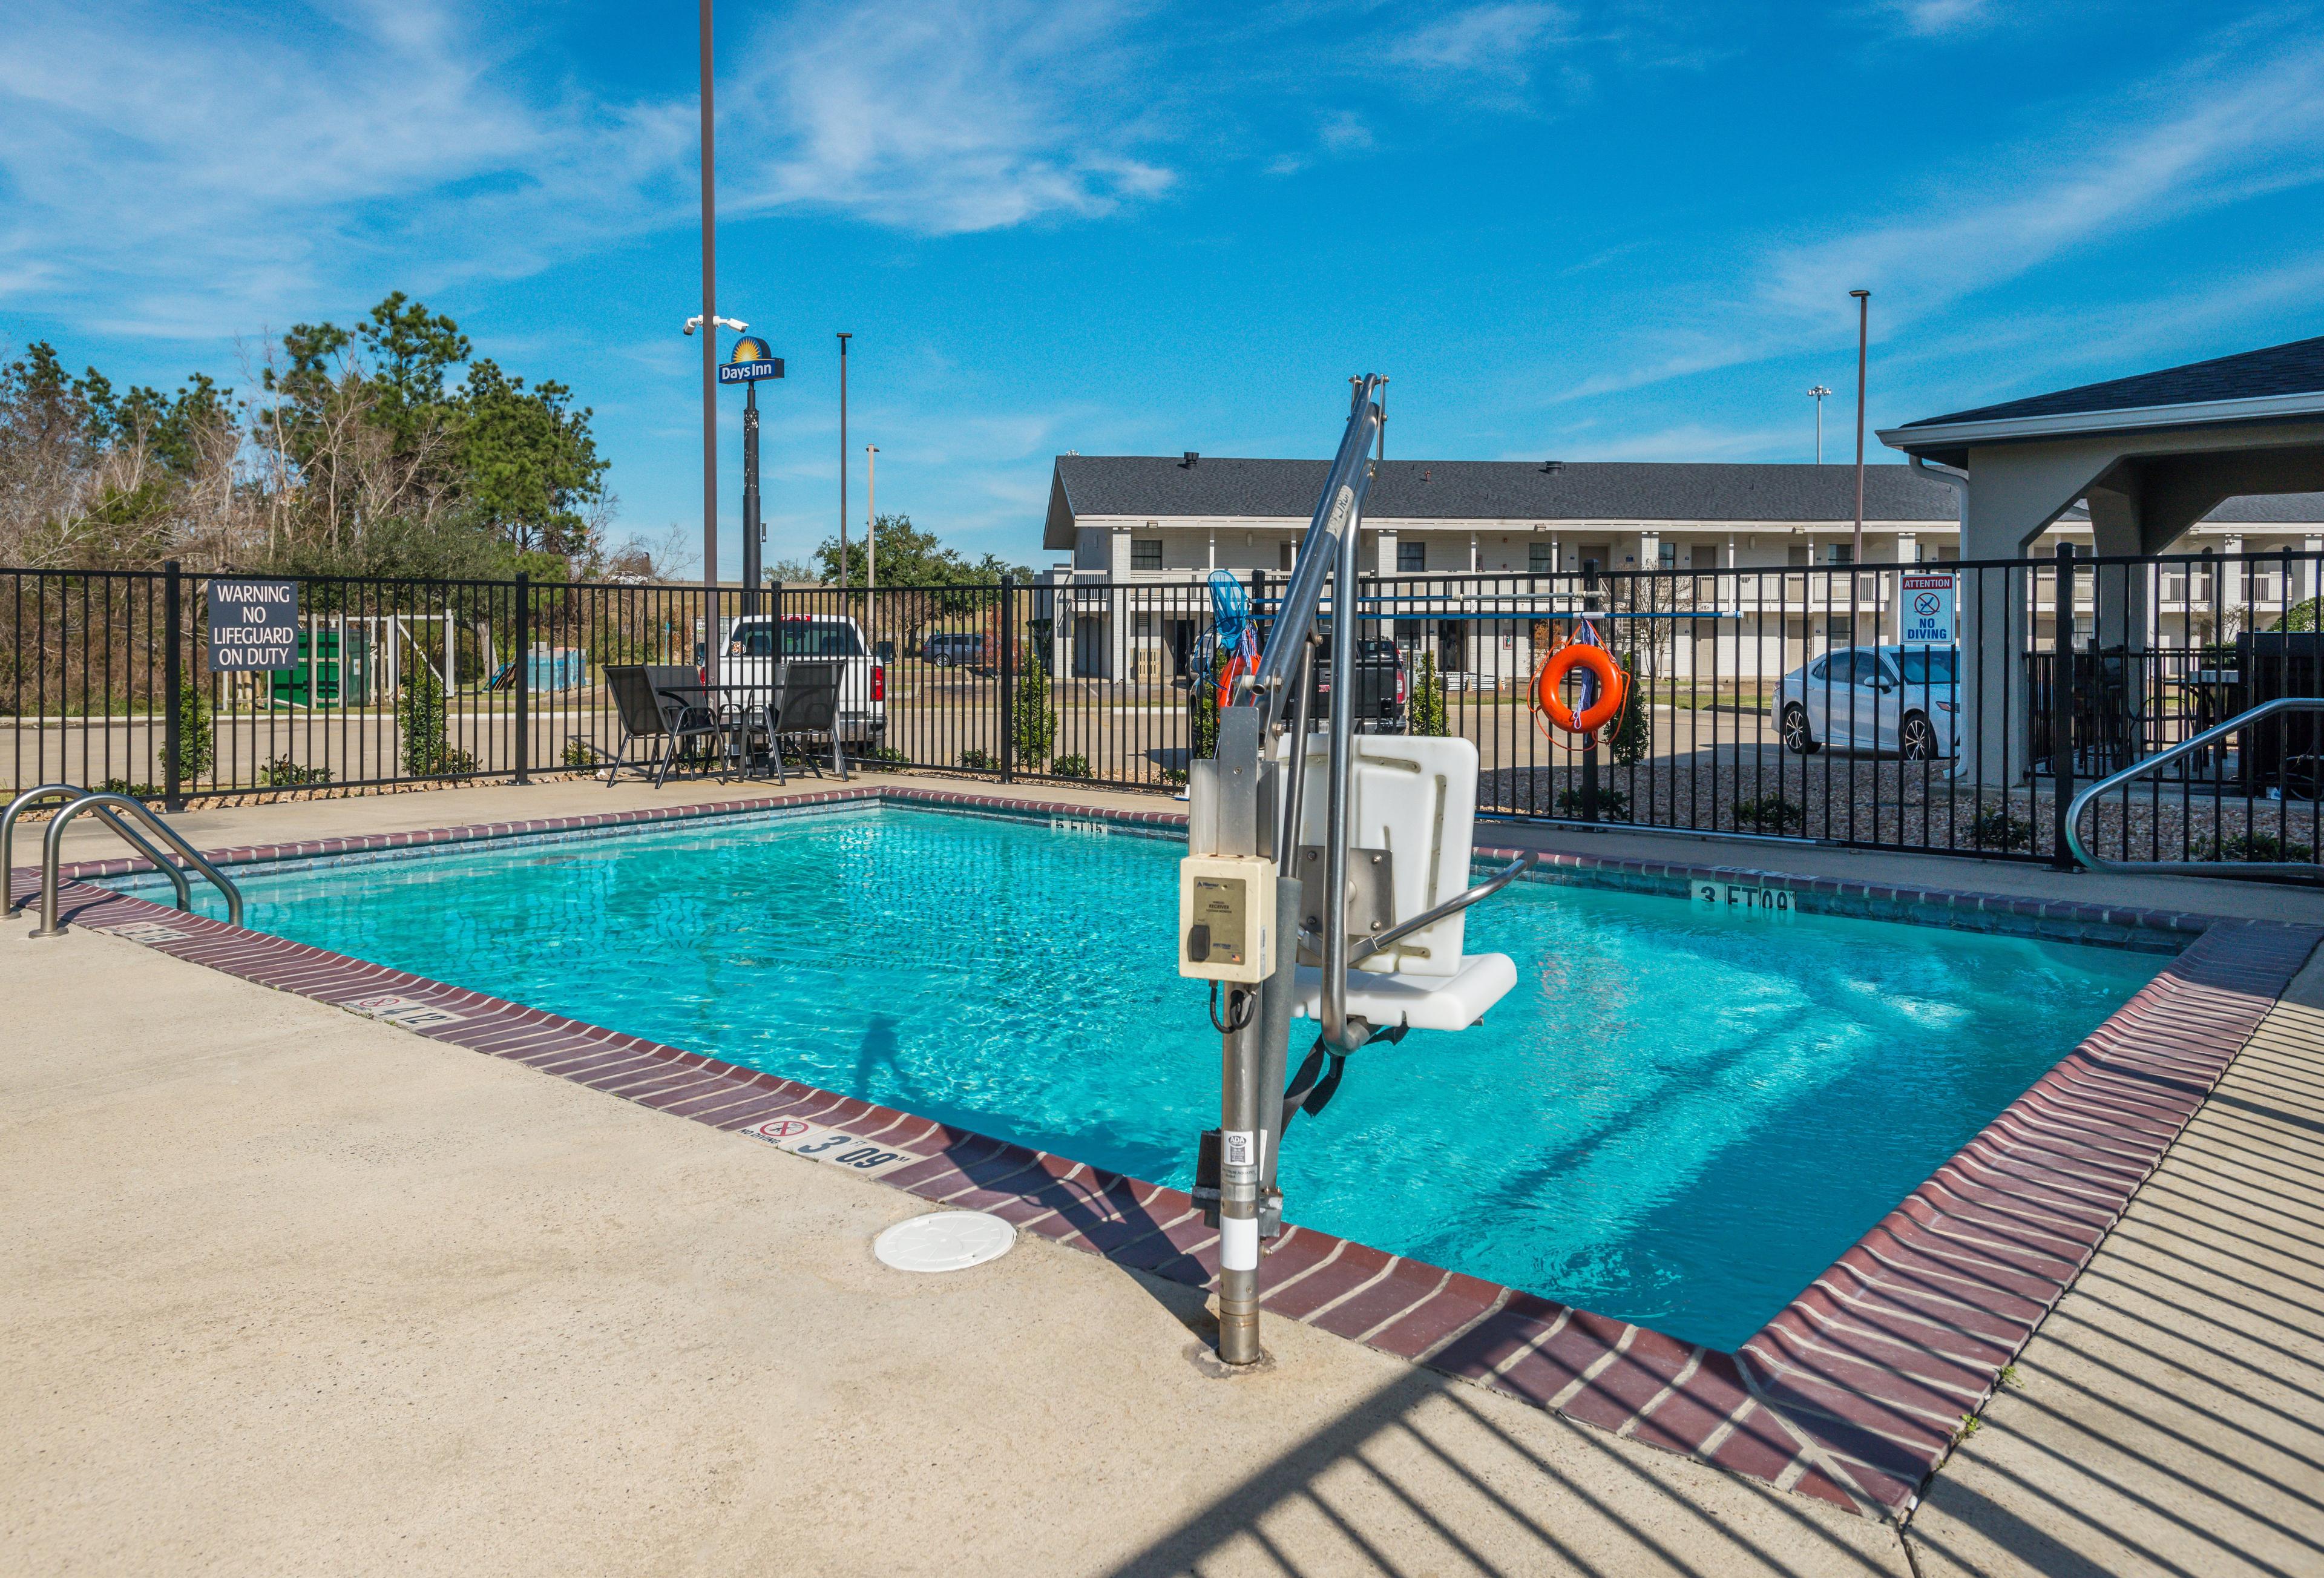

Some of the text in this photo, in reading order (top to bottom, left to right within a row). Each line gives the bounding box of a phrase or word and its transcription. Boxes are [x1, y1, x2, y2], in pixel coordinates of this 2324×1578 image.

[721, 363, 772, 380] Days Inn
[1904, 579, 1950, 588] ATTENTION
[217, 585, 290, 603] WARNING
[243, 606, 266, 623] NO
[1919, 618, 1935, 628] NO
[214, 627, 294, 645] LIFEGUARD
[1908, 628, 1947, 639] DIVING
[218, 648, 289, 665] ON DUTY
[1071, 818, 1086, 832] FT
[1700, 886, 1716, 902] 3
[1727, 886, 1758, 907] FT
[378, 1006, 426, 1016] 4
[750, 1132, 781, 1145] DIVING
[797, 1136, 852, 1154] 3
